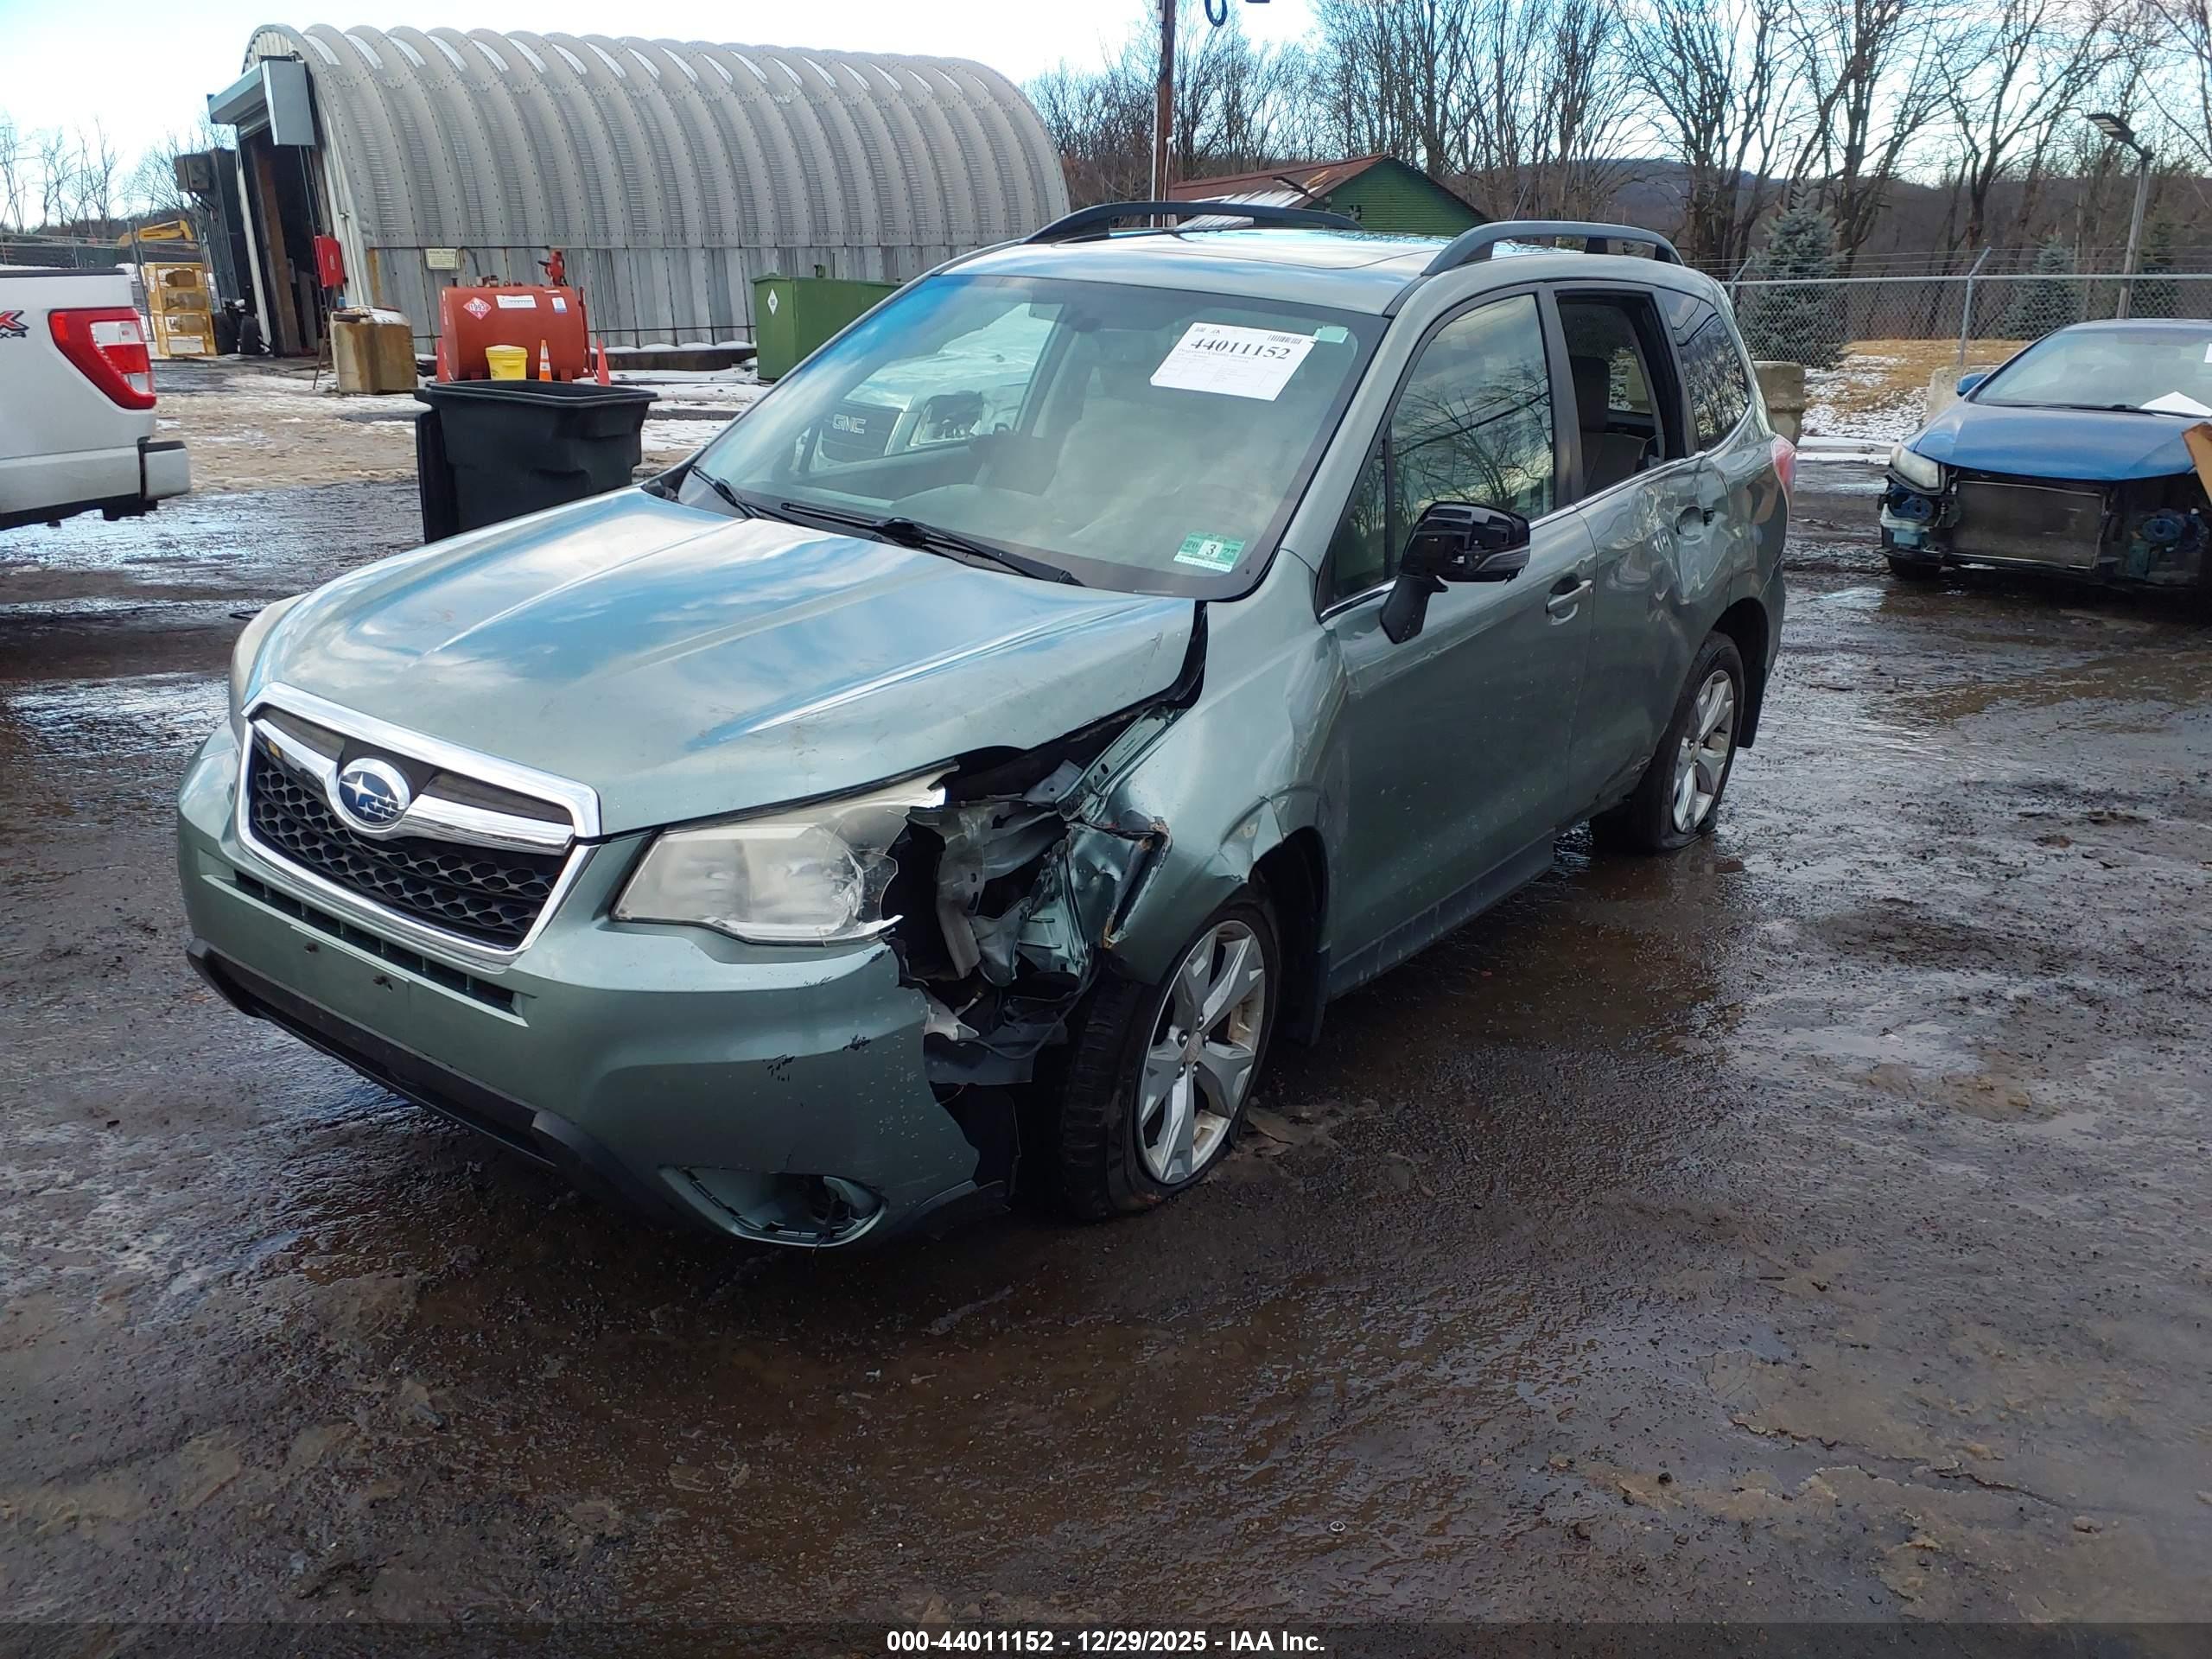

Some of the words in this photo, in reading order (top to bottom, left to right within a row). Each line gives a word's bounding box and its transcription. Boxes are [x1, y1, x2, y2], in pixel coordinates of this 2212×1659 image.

[1191, 338, 1291, 359] 44011152
[832, 414, 866, 434] GMC
[1206, 543, 1217, 555] 3
